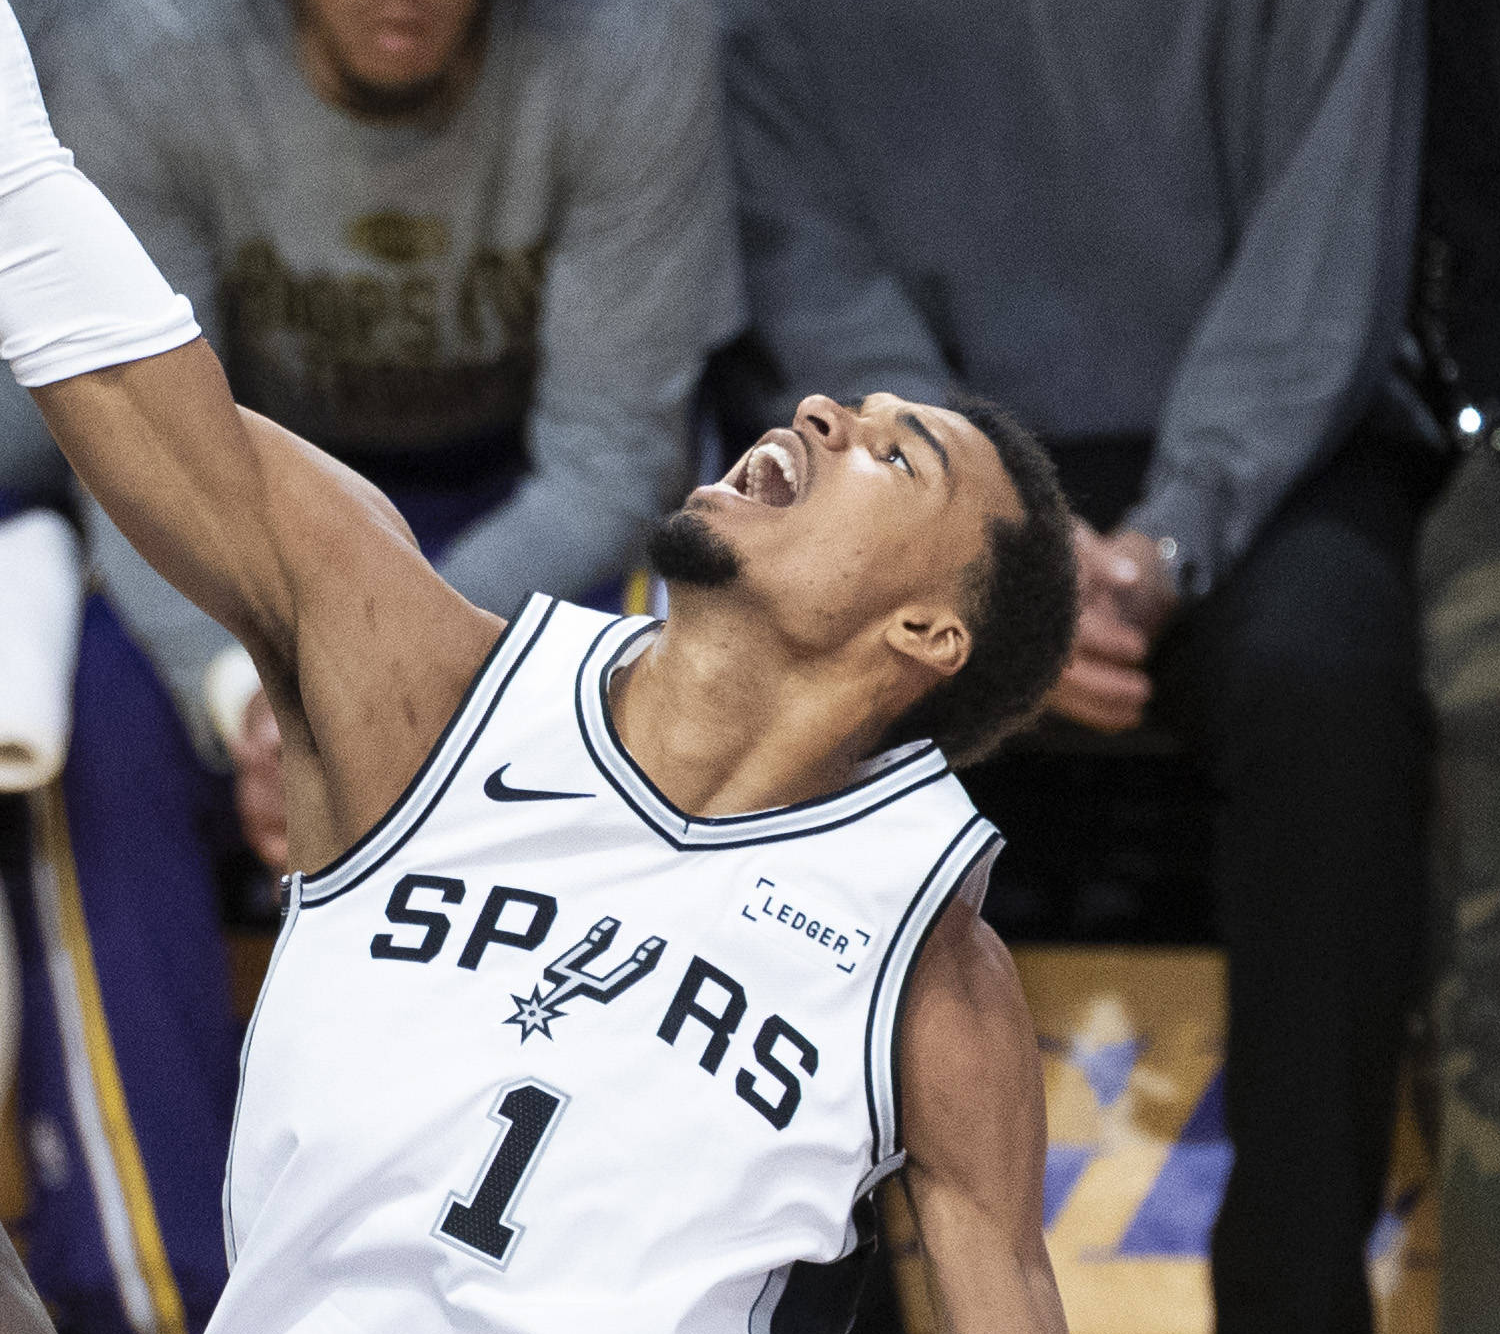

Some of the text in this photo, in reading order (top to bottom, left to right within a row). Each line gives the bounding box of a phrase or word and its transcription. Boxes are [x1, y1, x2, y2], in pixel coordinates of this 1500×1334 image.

[370, 873, 819, 1131] SPURS
[761, 895, 850, 955] LEDGER
[430, 1075, 572, 1273] 1
